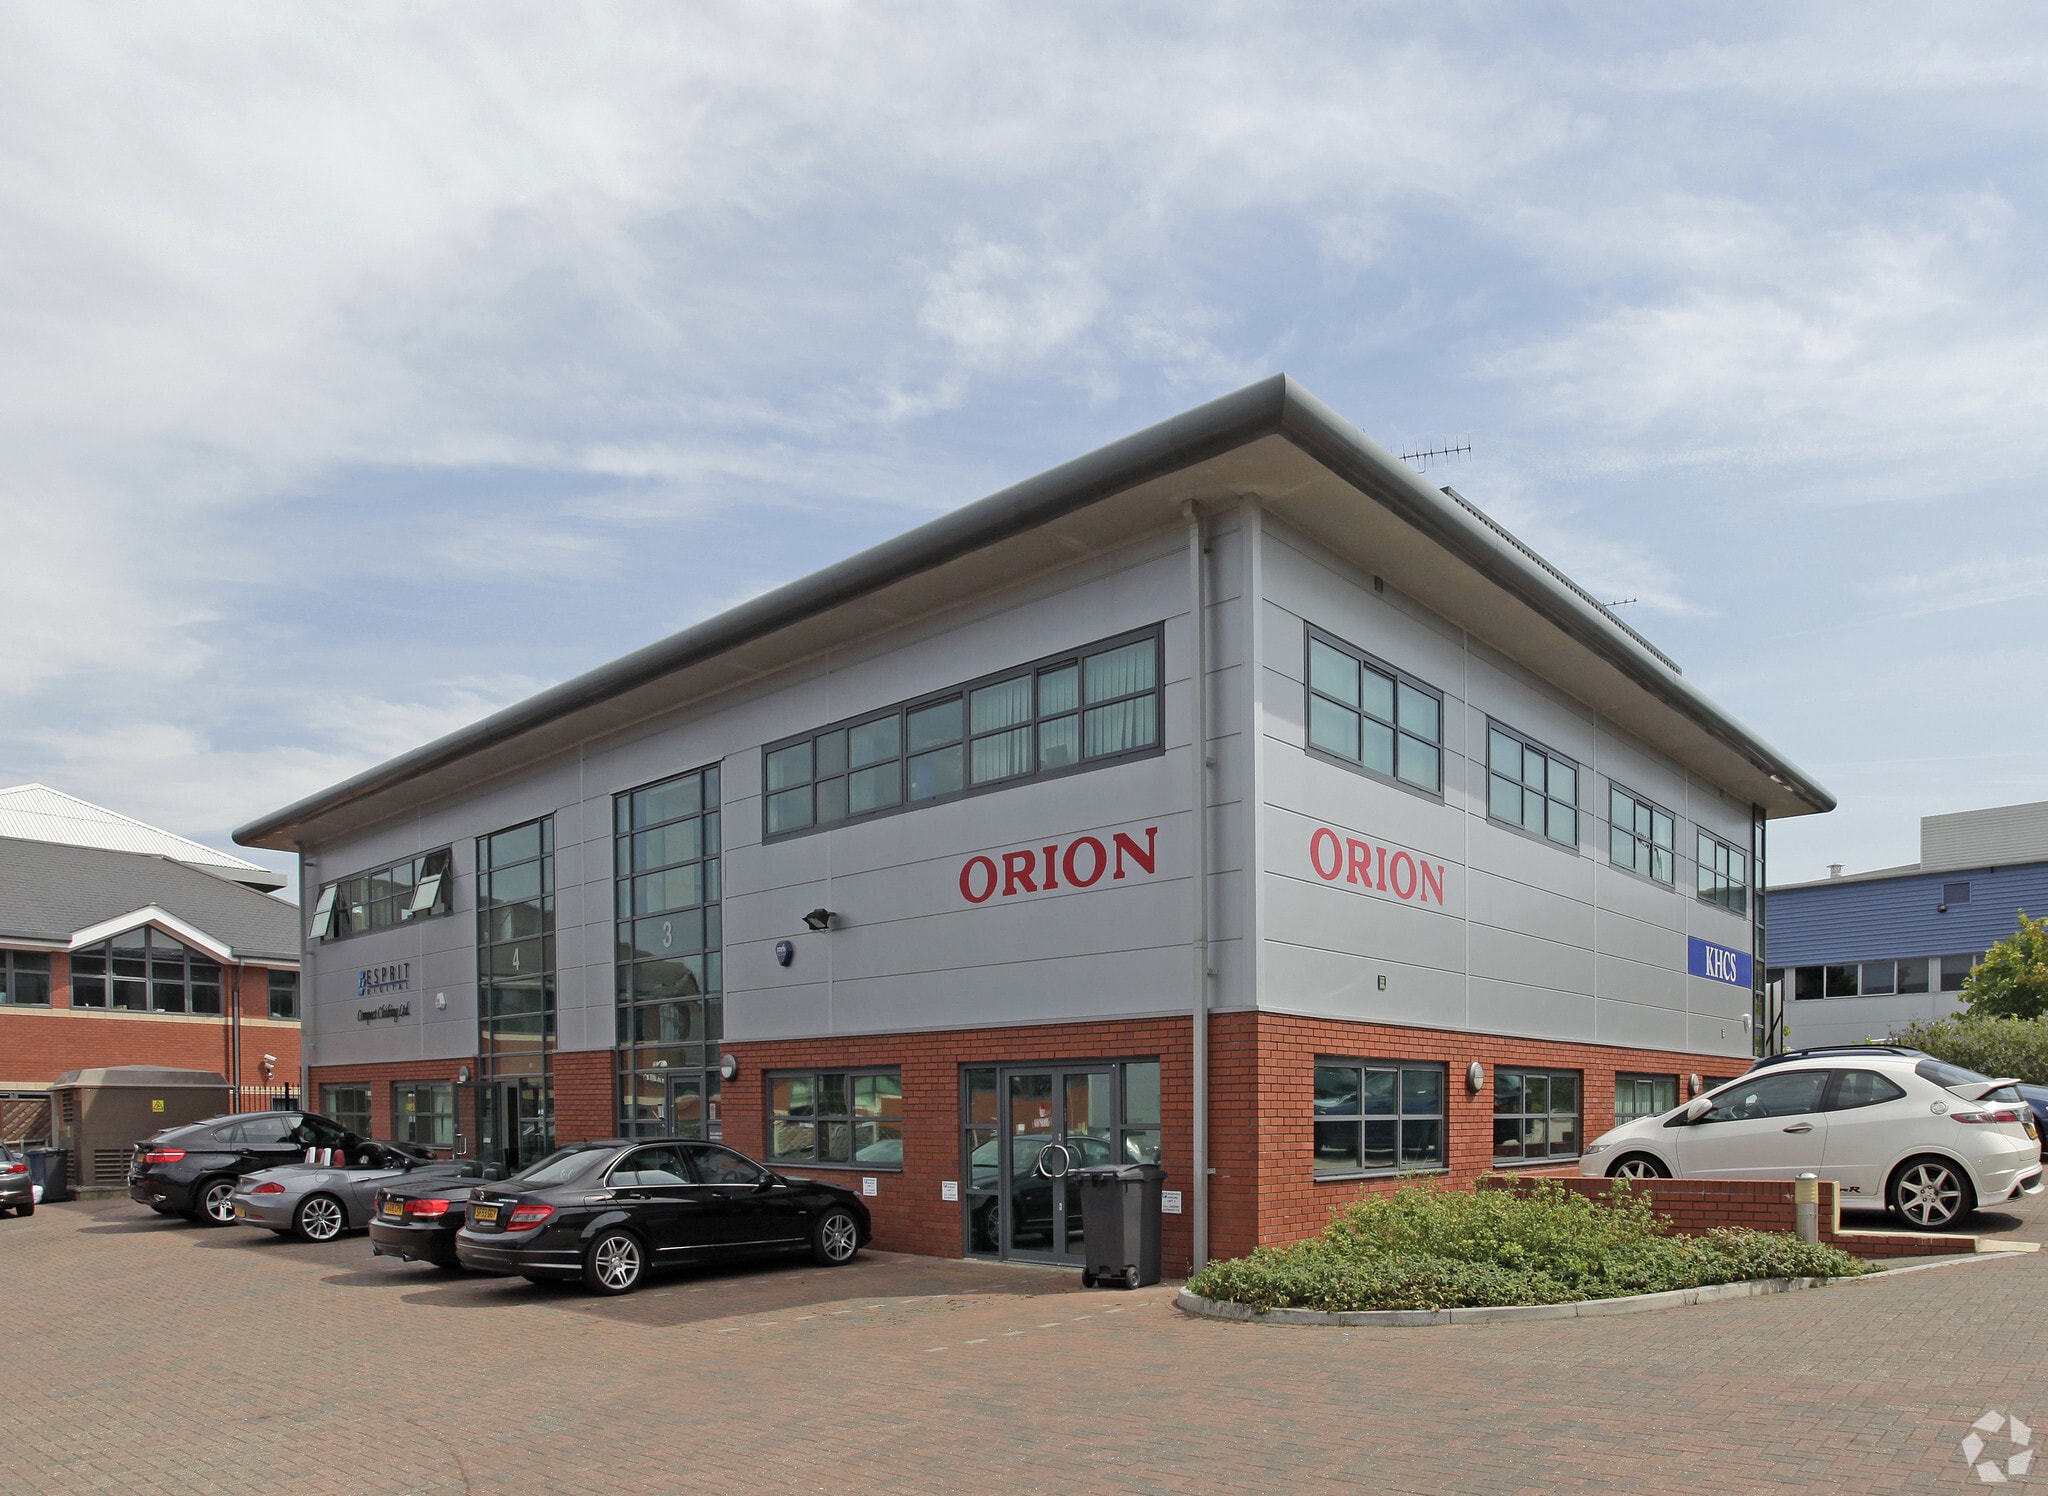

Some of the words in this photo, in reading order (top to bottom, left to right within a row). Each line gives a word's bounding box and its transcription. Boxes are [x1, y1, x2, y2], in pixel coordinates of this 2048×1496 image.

[959, 827, 1157, 903] ORION
[1309, 827, 1444, 905] ORION
[663, 921, 672, 948] 3
[512, 947, 519, 970] 4
[1705, 945, 1736, 982] KHCS
[366, 962, 409, 985] ESPRIT
[366, 983, 408, 995] DIGITAL
